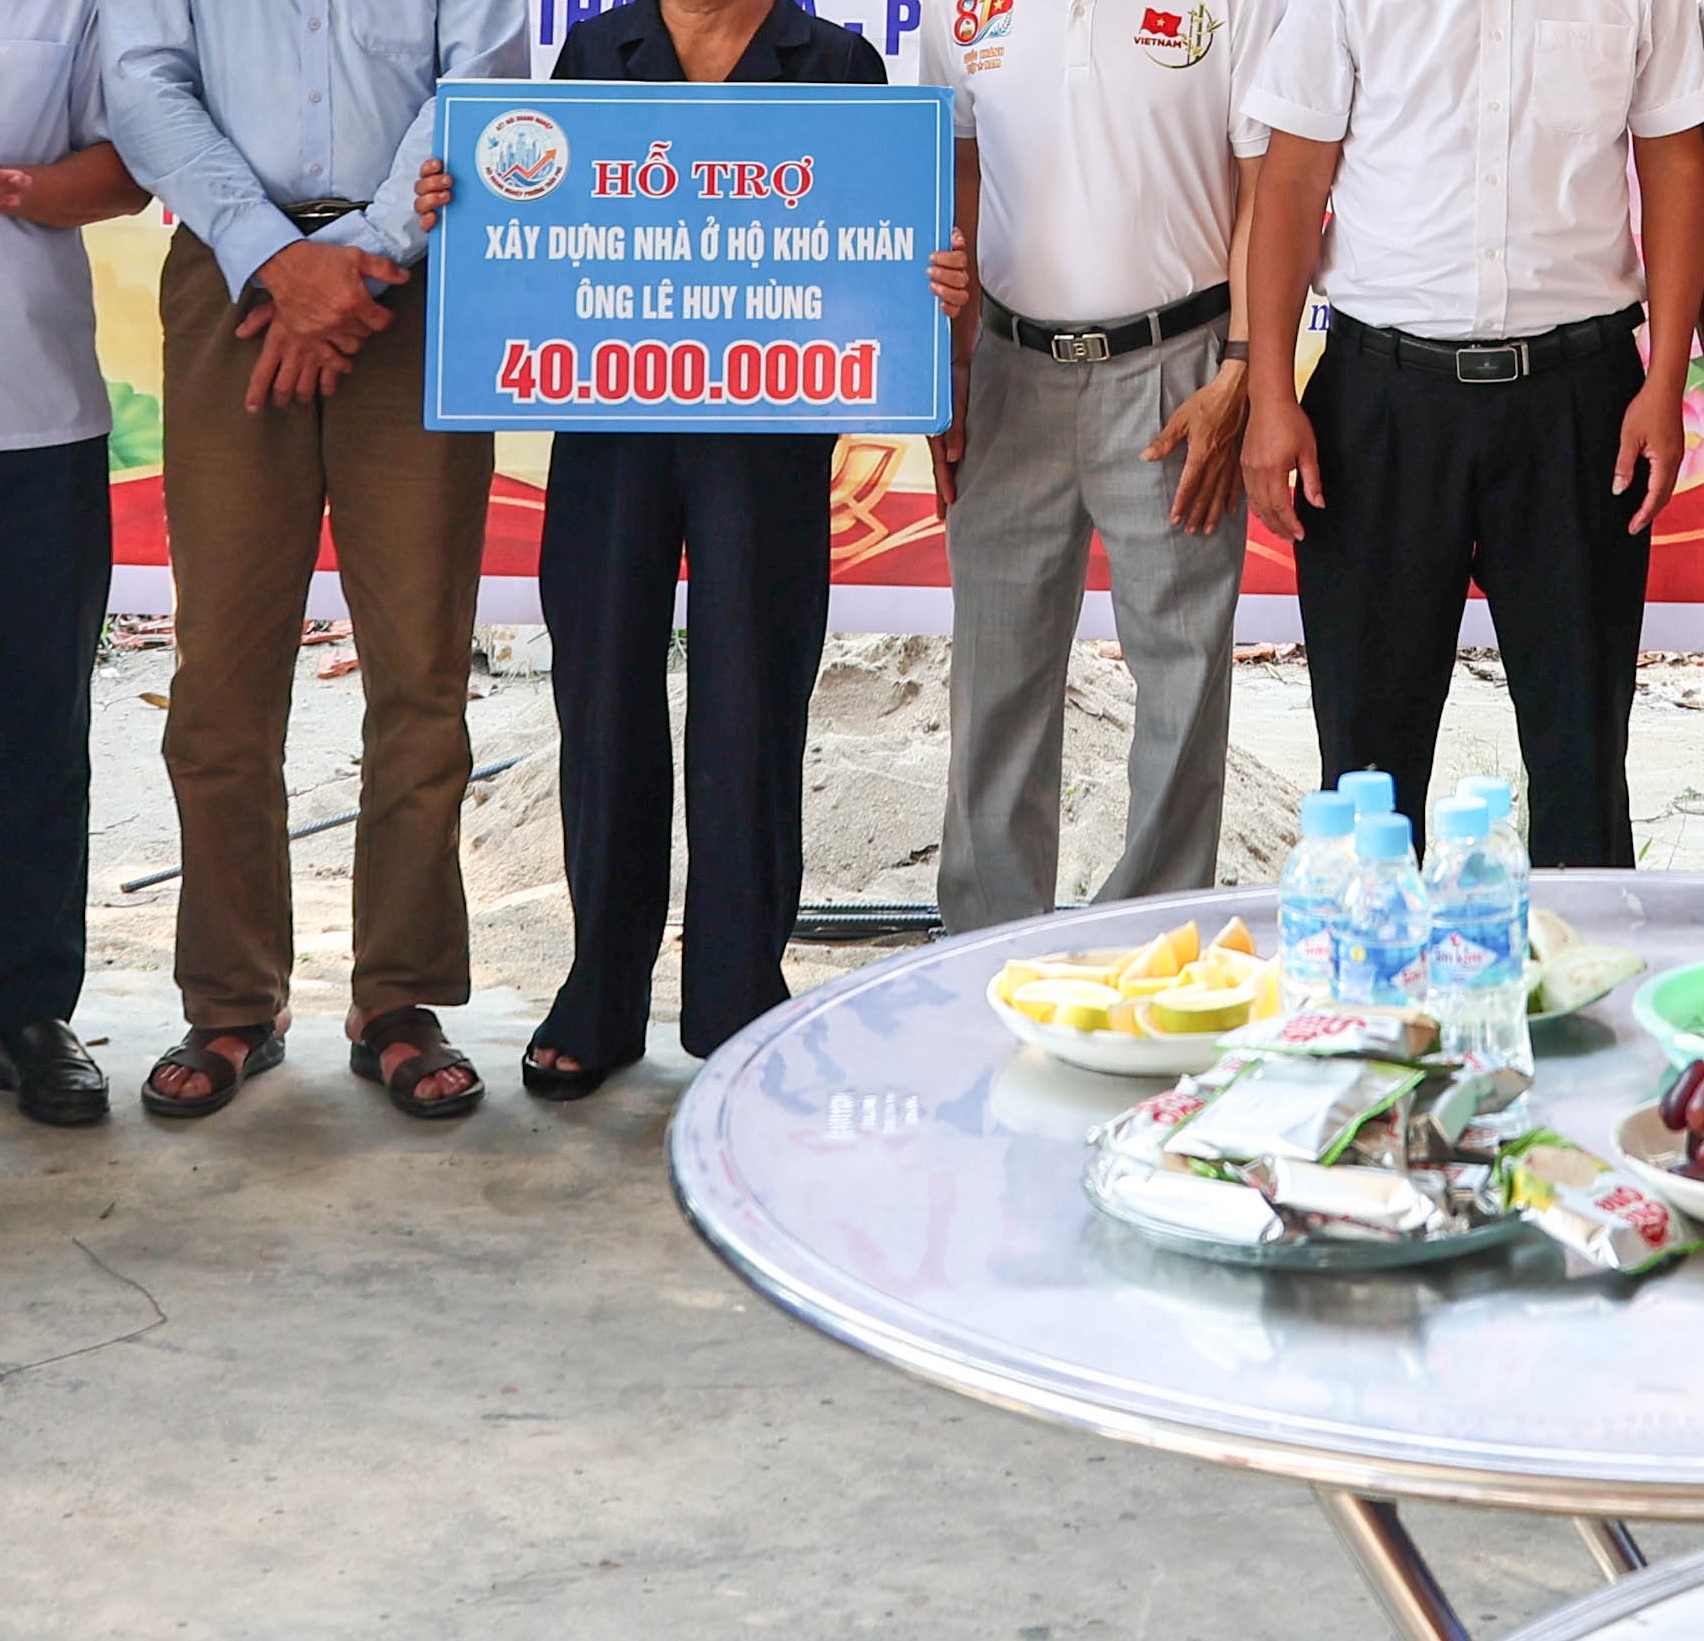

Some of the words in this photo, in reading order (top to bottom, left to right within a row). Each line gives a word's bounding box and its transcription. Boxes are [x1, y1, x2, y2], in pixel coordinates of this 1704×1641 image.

[1133, 36, 1183, 49] VIETNAM
[593, 142, 677, 198] HỖ
[693, 156, 814, 208] TRỢ
[485, 218, 540, 260] XÂY
[548, 223, 625, 267] DỰNG
[634, 219, 692, 261] NHÀ
[701, 216, 720, 261] Ở
[727, 219, 765, 267] HỘ
[773, 219, 829, 261] KHÓ
[838, 219, 914, 261] KHĂN
[575, 278, 634, 319] ÔNG
[643, 278, 674, 319] LÊ
[683, 285, 738, 319] HUY
[745, 278, 822, 320] HÙNG
[499, 342, 879, 401] 40.000.000đ
